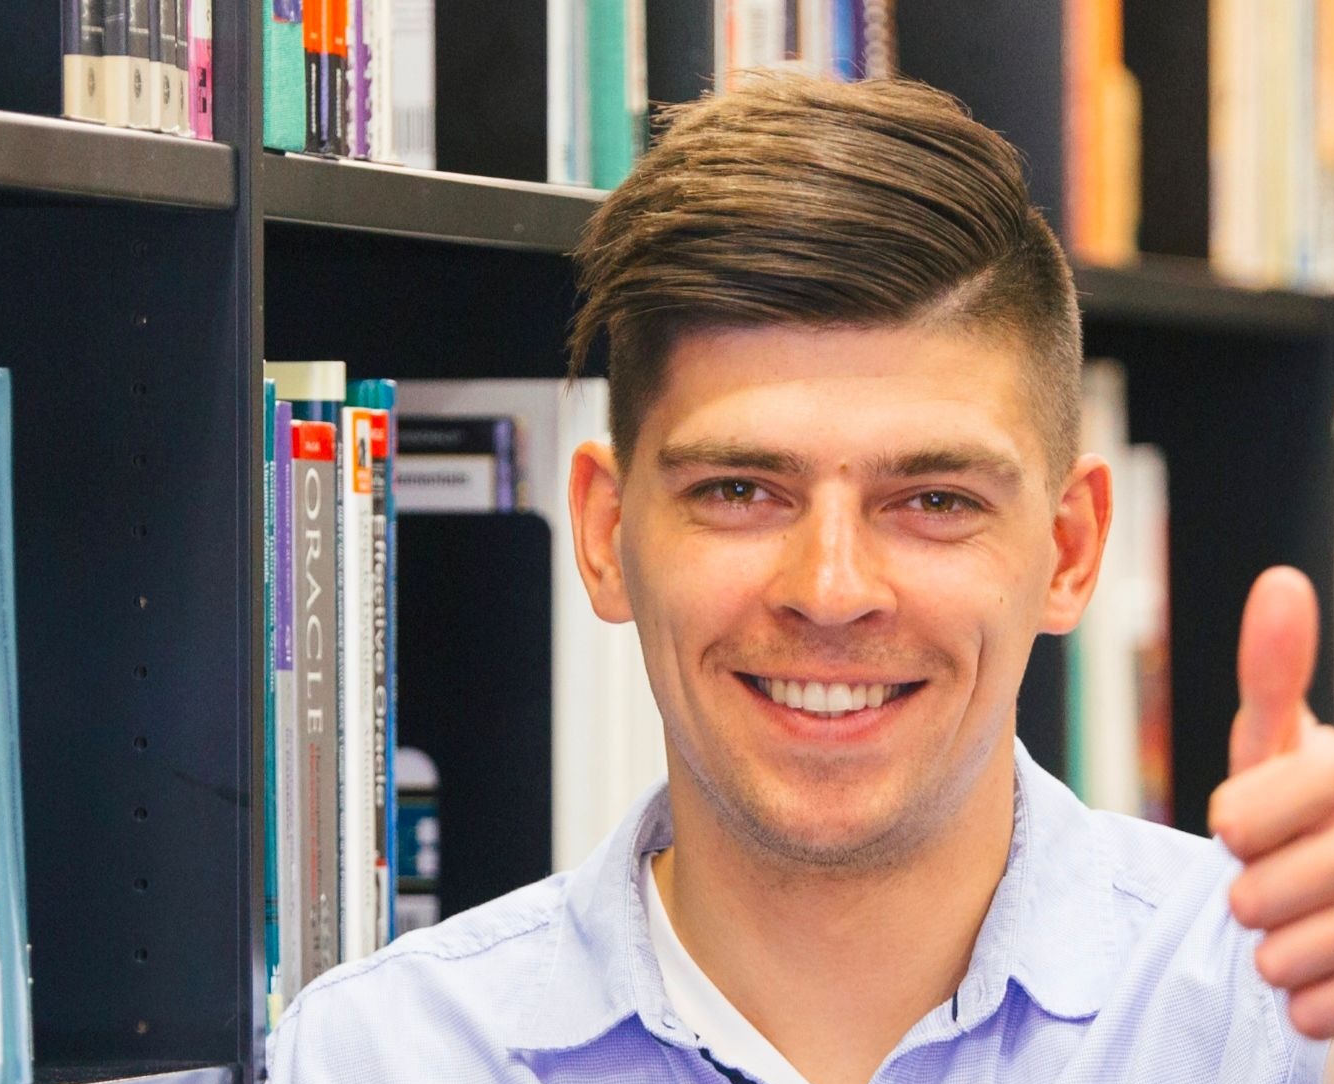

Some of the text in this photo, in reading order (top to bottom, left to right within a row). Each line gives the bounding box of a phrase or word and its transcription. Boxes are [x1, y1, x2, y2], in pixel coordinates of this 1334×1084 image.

[303, 466, 324, 736] ORACLE
[372, 515, 388, 807] Effective Oracle
